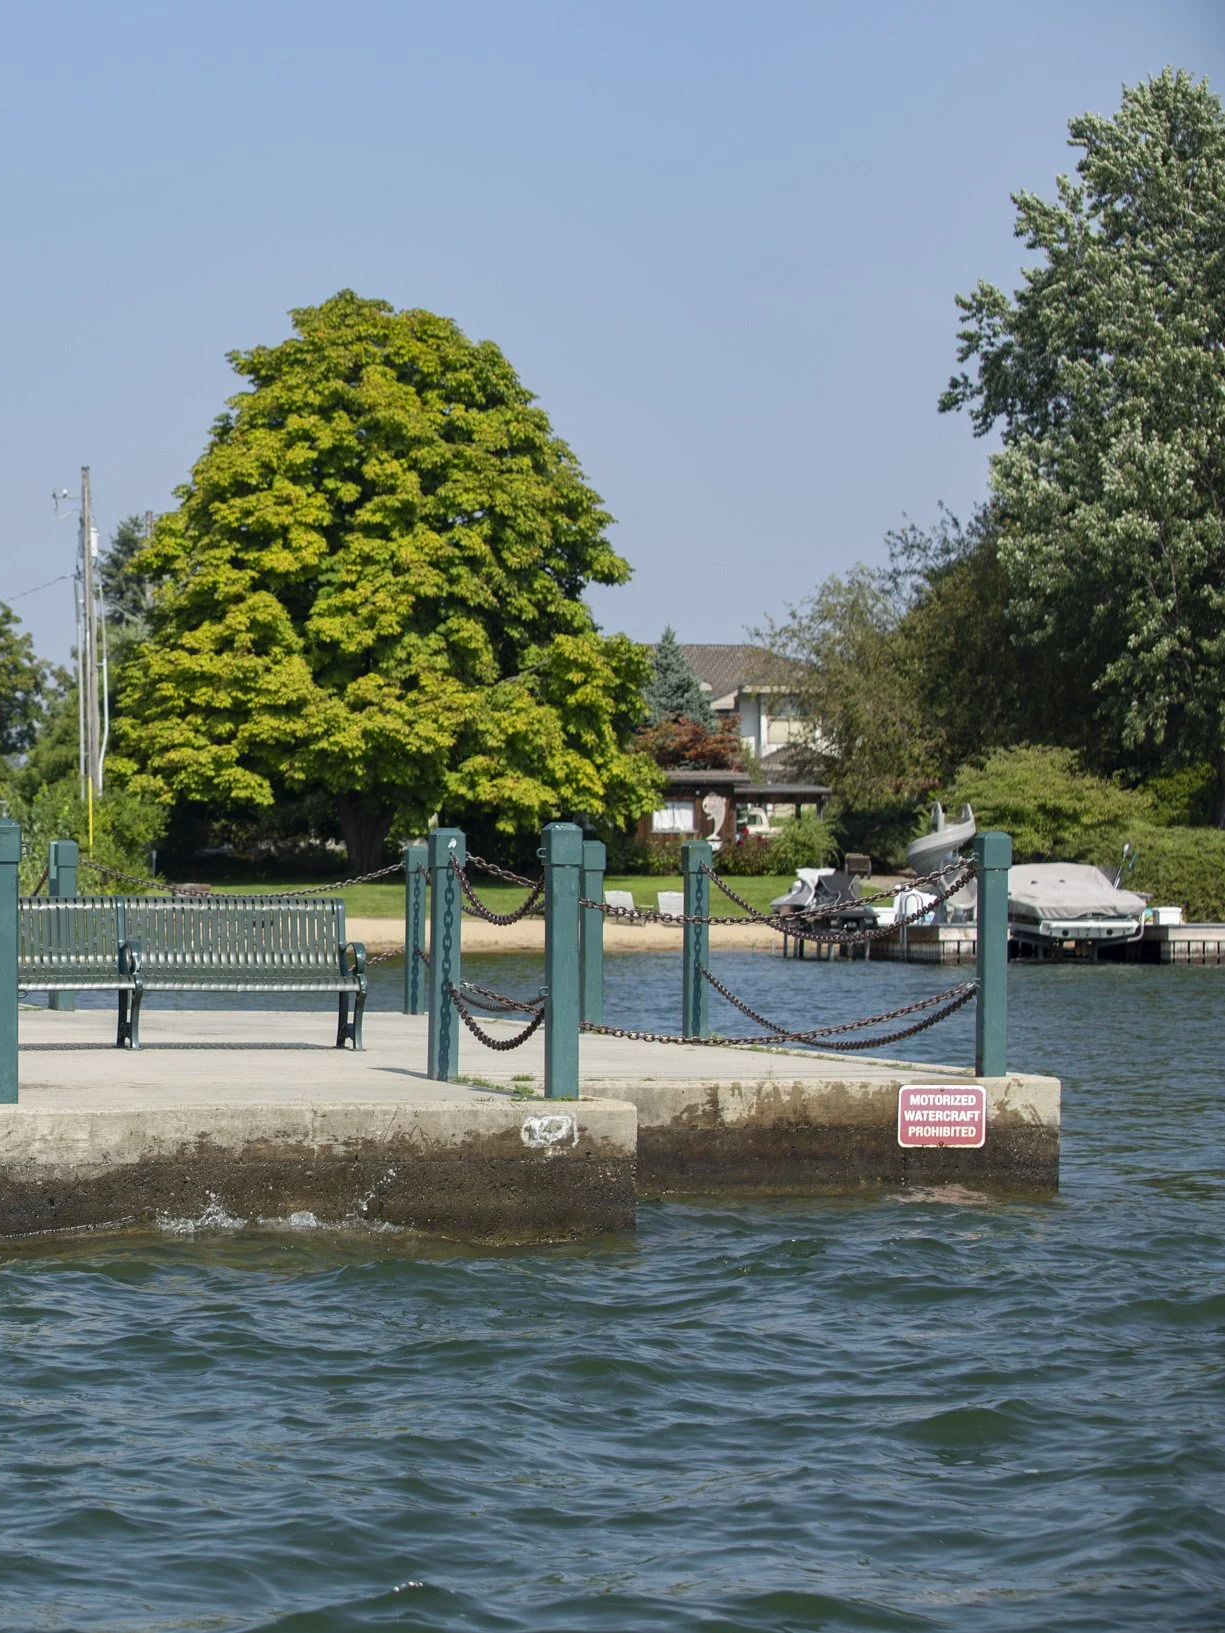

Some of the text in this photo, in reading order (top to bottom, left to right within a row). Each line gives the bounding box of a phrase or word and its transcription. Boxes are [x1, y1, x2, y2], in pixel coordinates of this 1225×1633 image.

[909, 1094, 976, 1106] MOTORIZED
[904, 1110, 980, 1122] WATERCRAFT
[908, 1126, 976, 1137] PROHIBITED
